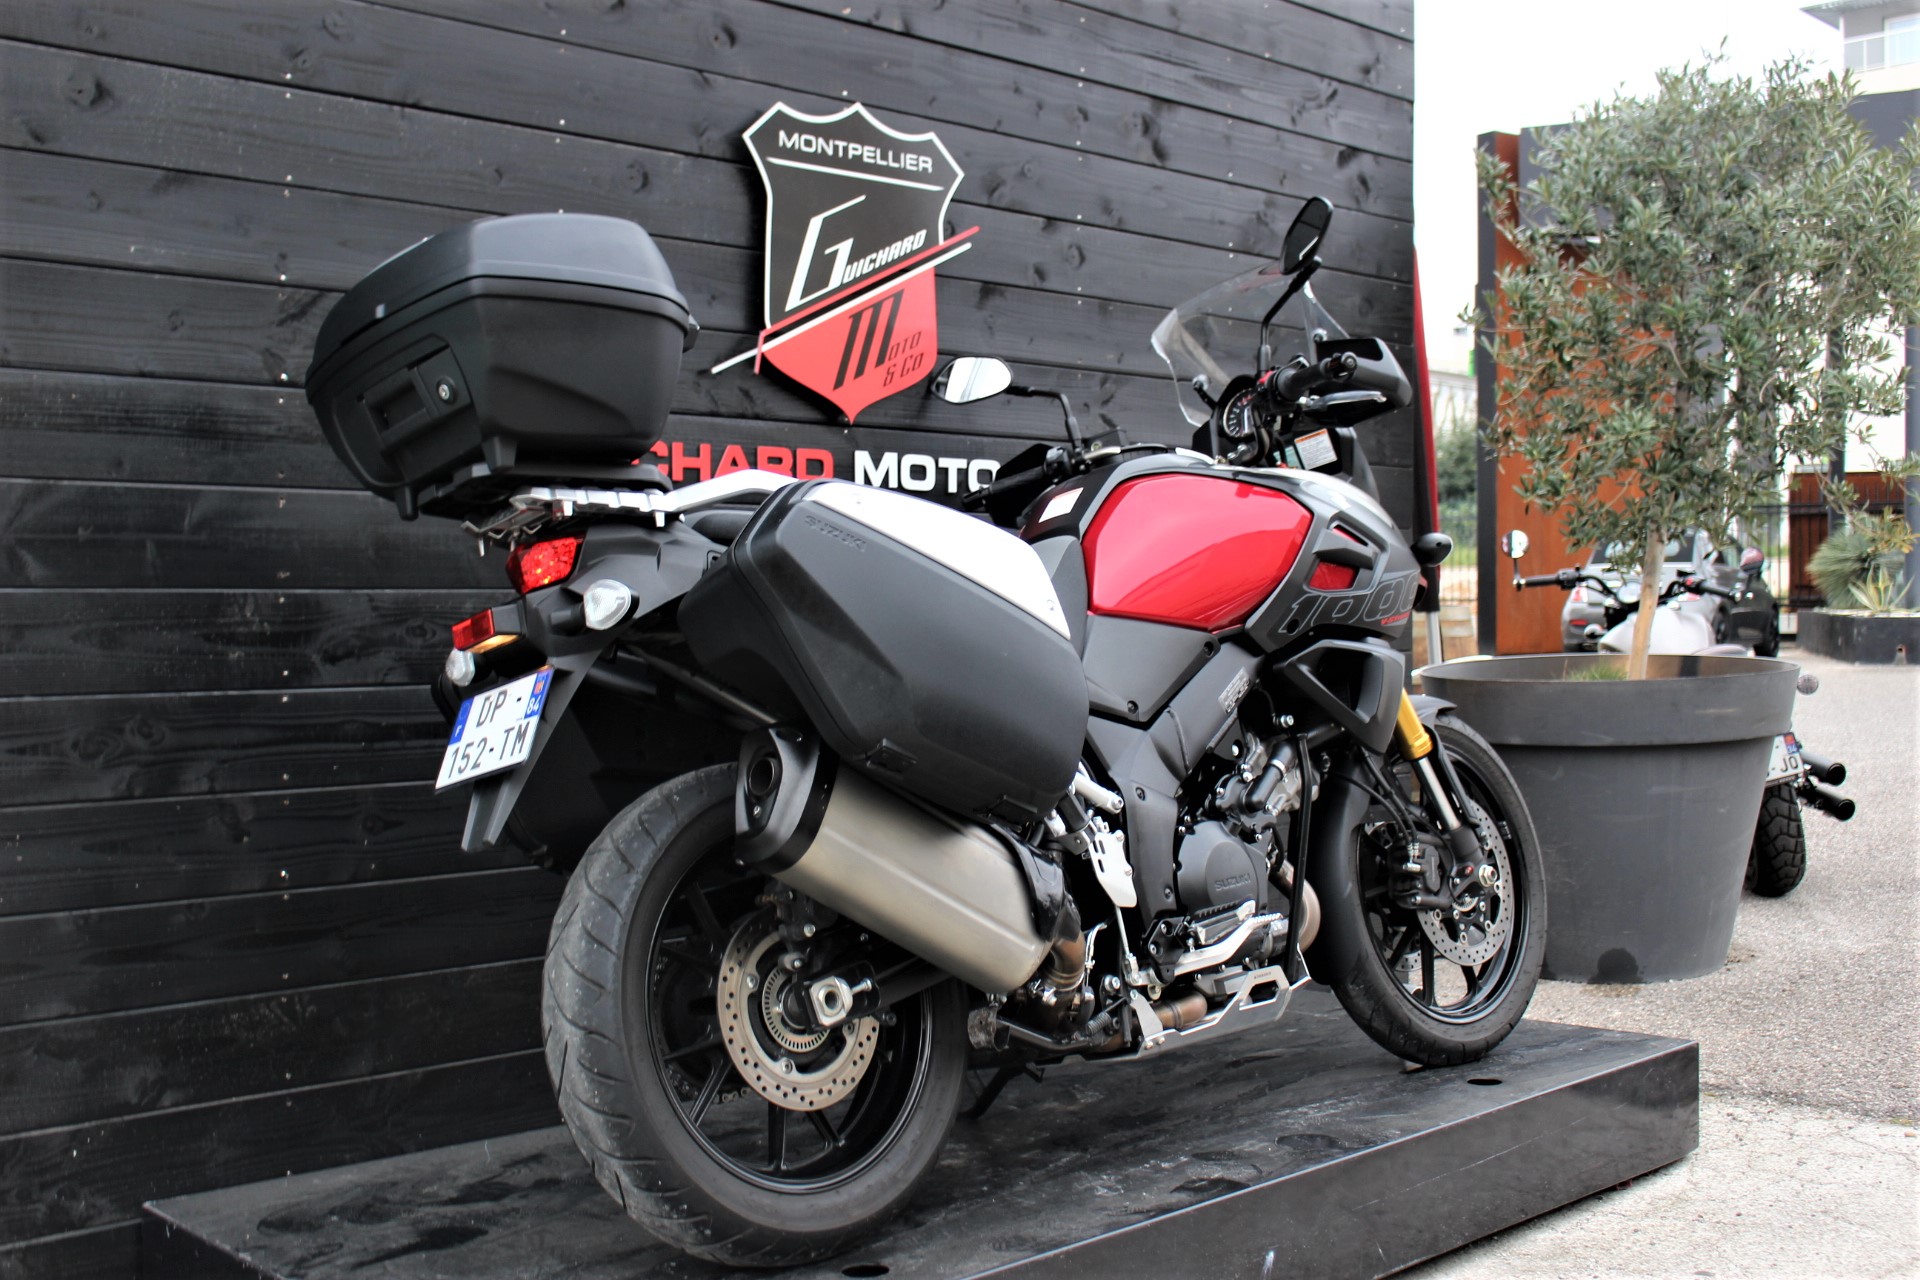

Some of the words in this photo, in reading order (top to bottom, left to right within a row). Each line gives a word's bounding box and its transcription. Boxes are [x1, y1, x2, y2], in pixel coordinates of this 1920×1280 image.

[778, 129, 933, 173] MONTPELLIER
[631, 439, 834, 483] HARD
[854, 450, 1001, 494] MOTO
[526, 695, 542, 714] 84
[448, 720, 531, 779] 152-TM
[1214, 872, 1251, 891] SUZUKI
